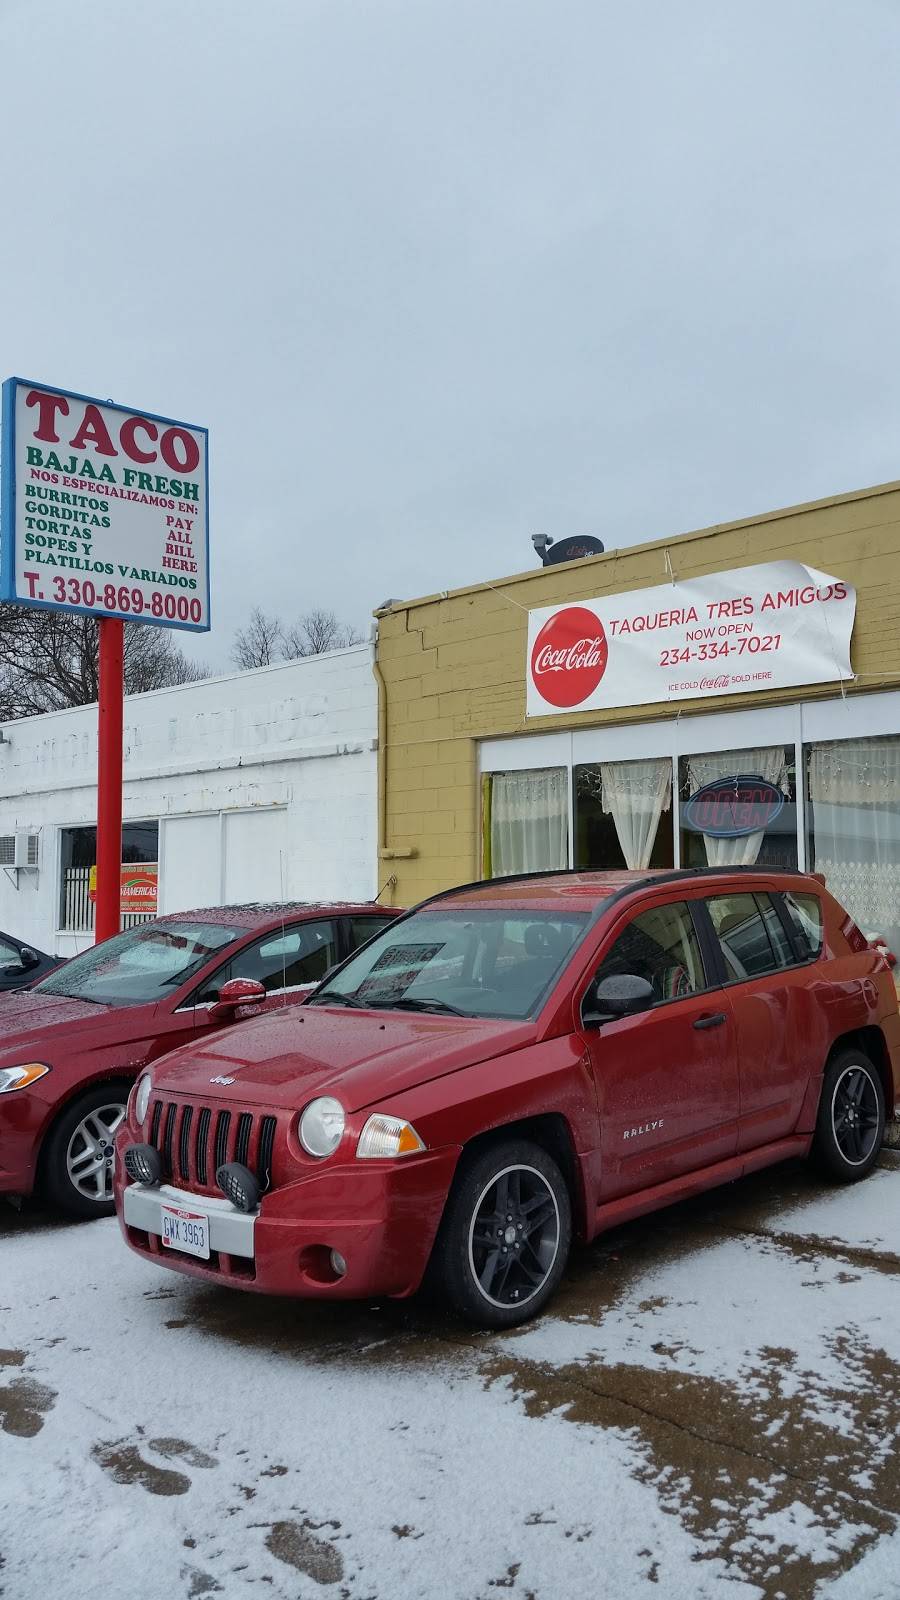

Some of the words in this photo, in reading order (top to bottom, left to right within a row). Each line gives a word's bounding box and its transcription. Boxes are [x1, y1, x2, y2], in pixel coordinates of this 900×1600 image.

[25, 390, 200, 474] TACO
[26, 446, 116, 483] BAJAA
[123, 467, 199, 501] FRESH
[25, 484, 109, 512] BURRITOS
[30, 468, 59, 484] NOS
[62, 475, 175, 510] ESPECIALIZAMOS
[178, 502, 198, 515] EN:
[25, 501, 111, 528] GORDITAS
[25, 516, 92, 540] TORTAS
[166, 515, 194, 531] PAY
[25, 533, 77, 553] SOPES
[82, 542, 93, 556] Y
[165, 542, 195, 559] BILL
[167, 530, 193, 544] ALL
[25, 549, 114, 575] PLATILLOS
[118, 565, 197, 589] VARIADOS
[162, 556, 198, 573] HERE
[24, 571, 44, 600] T.
[52, 575, 202, 623] 330-869-8000
[609, 606, 698, 636] TAQUERIA
[706, 597, 754, 620] TRES
[761, 582, 848, 612] AMIGOS
[686, 627, 715, 642] NOW
[718, 622, 753, 637] OPEN
[659, 634, 782, 667] 234-334-7021
[668, 683, 679, 691] ICE
[680, 681, 699, 690] COLD
[731, 674, 751, 683] SOLD
[752, 671, 772, 680] HERE
[695, 788, 774, 827] OPEN
[623, 1119, 664, 1139] RALLYE
[164, 1216, 180, 1240] GWX
[183, 1221, 205, 1247] 3963
